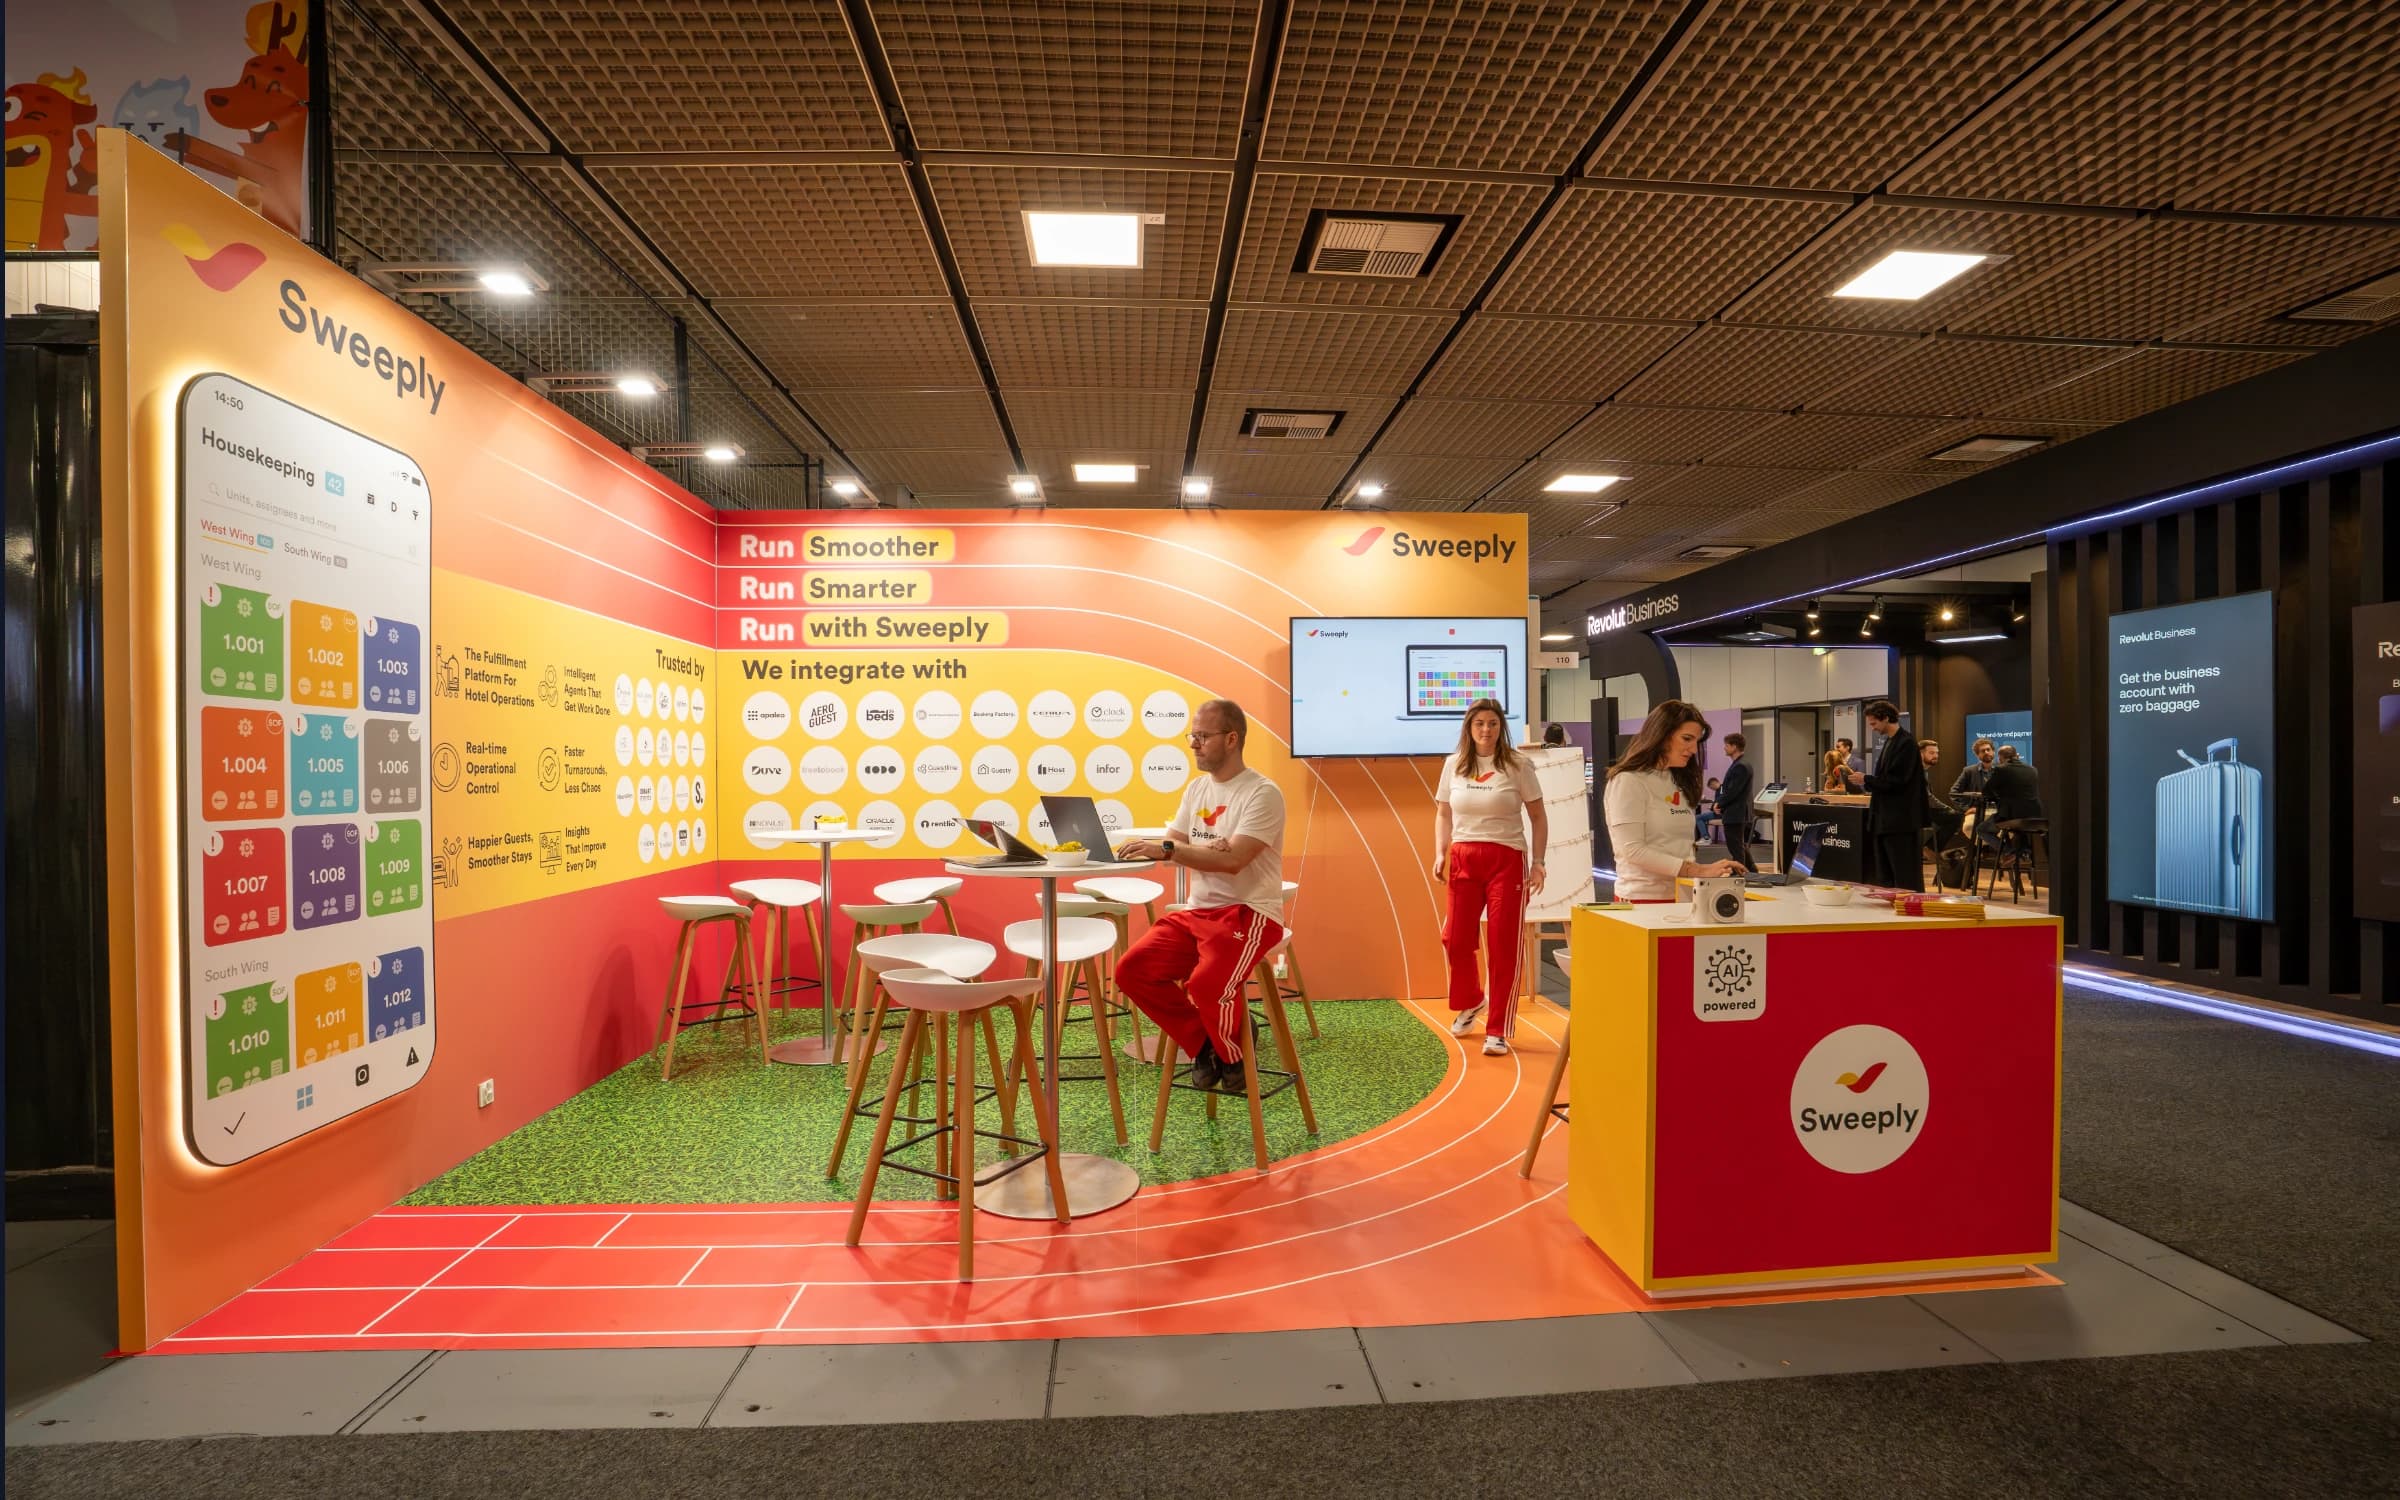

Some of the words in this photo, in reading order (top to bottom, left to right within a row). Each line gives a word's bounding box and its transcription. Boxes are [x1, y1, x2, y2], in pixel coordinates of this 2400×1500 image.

[278, 279, 446, 415] Sweeply
[214, 390, 244, 411] 14:50
[202, 427, 315, 487] Housekeeping
[226, 487, 253, 507] Units,
[256, 500, 298, 519] assignees
[300, 513, 315, 525] and
[201, 519, 227, 536] West
[230, 527, 255, 546] Wing
[284, 542, 309, 557] South
[311, 550, 332, 566] Wing
[740, 534, 794, 558] Run
[809, 535, 939, 557] Smoother
[1392, 532, 1516, 563] Sweeply
[201, 553, 231, 571] West
[233, 560, 262, 580] Wing
[740, 576, 794, 600] Run
[809, 577, 917, 599] Smarter
[1588, 605, 1626, 637] Revolut
[1626, 594, 1680, 624] Business
[740, 617, 794, 641] Run
[810, 616, 867, 638] with
[875, 615, 989, 643] Sweeply
[1320, 630, 1349, 638] Sweeply
[2119, 631, 2153, 645] Revolut
[2154, 626, 2196, 640] Business
[223, 634, 265, 654] 1.001
[307, 647, 344, 667] 1.002
[465, 647, 481, 662] The
[483, 651, 527, 670] Fulfillment
[656, 648, 692, 675] Trusted
[694, 658, 705, 682] by
[1556, 656, 1570, 664] 110
[377, 658, 409, 676] 1.003
[564, 666, 596, 682] Intelligent
[742, 659, 783, 680] We
[791, 659, 905, 685] integrate
[912, 658, 967, 679] with
[2119, 672, 2140, 685] Get
[2142, 670, 2161, 683] the
[2164, 665, 2220, 681] business
[465, 667, 502, 684] Platform
[504, 674, 517, 687] For
[465, 688, 489, 703] Hotel
[491, 691, 535, 708] Operations
[564, 683, 586, 698] Agents
[588, 687, 602, 699] That
[2119, 686, 2166, 699] account
[2168, 682, 2195, 695] with
[564, 701, 577, 713] Get
[578, 703, 594, 715] Work
[595, 705, 611, 716] Done
[811, 703, 834, 718] AERO
[2119, 702, 2143, 713] zero
[2146, 698, 2200, 713] baggage
[809, 711, 838, 728] GUEST
[466, 741, 507, 755] Real-time
[564, 745, 585, 757] Faster
[222, 757, 268, 774] 1.004
[307, 757, 344, 773] 1.005
[377, 760, 409, 774] 1.006
[466, 761, 516, 777] Operational
[565, 764, 608, 776] Turnarounds,
[1096, 763, 1121, 774] infor
[466, 782, 500, 795] Control
[565, 782, 580, 794] Less
[581, 781, 601, 793] Chaos
[565, 825, 590, 840] Insights
[931, 820, 956, 828] rentlio
[1039, 819, 1050, 828] str
[468, 834, 503, 851] Happier
[504, 832, 534, 846] Guests,
[566, 843, 581, 856] That
[582, 840, 607, 854] Improve
[1822, 836, 1851, 848] usiness
[379, 859, 410, 876] 1.009
[468, 853, 509, 870] Smoother
[511, 850, 533, 864] Stays
[566, 861, 584, 873] Every
[586, 858, 597, 870] Day
[309, 866, 346, 885] 1.008
[224, 875, 269, 896] 1.007
[205, 963, 238, 982] South
[241, 959, 269, 976] Wing
[1723, 964, 1739, 977] AI
[383, 988, 411, 1009] 1.012
[1703, 999, 1756, 1013] powered
[315, 1008, 346, 1030] 1.011
[228, 1029, 270, 1055] 1.010
[1800, 1102, 1919, 1134] Sweeply
